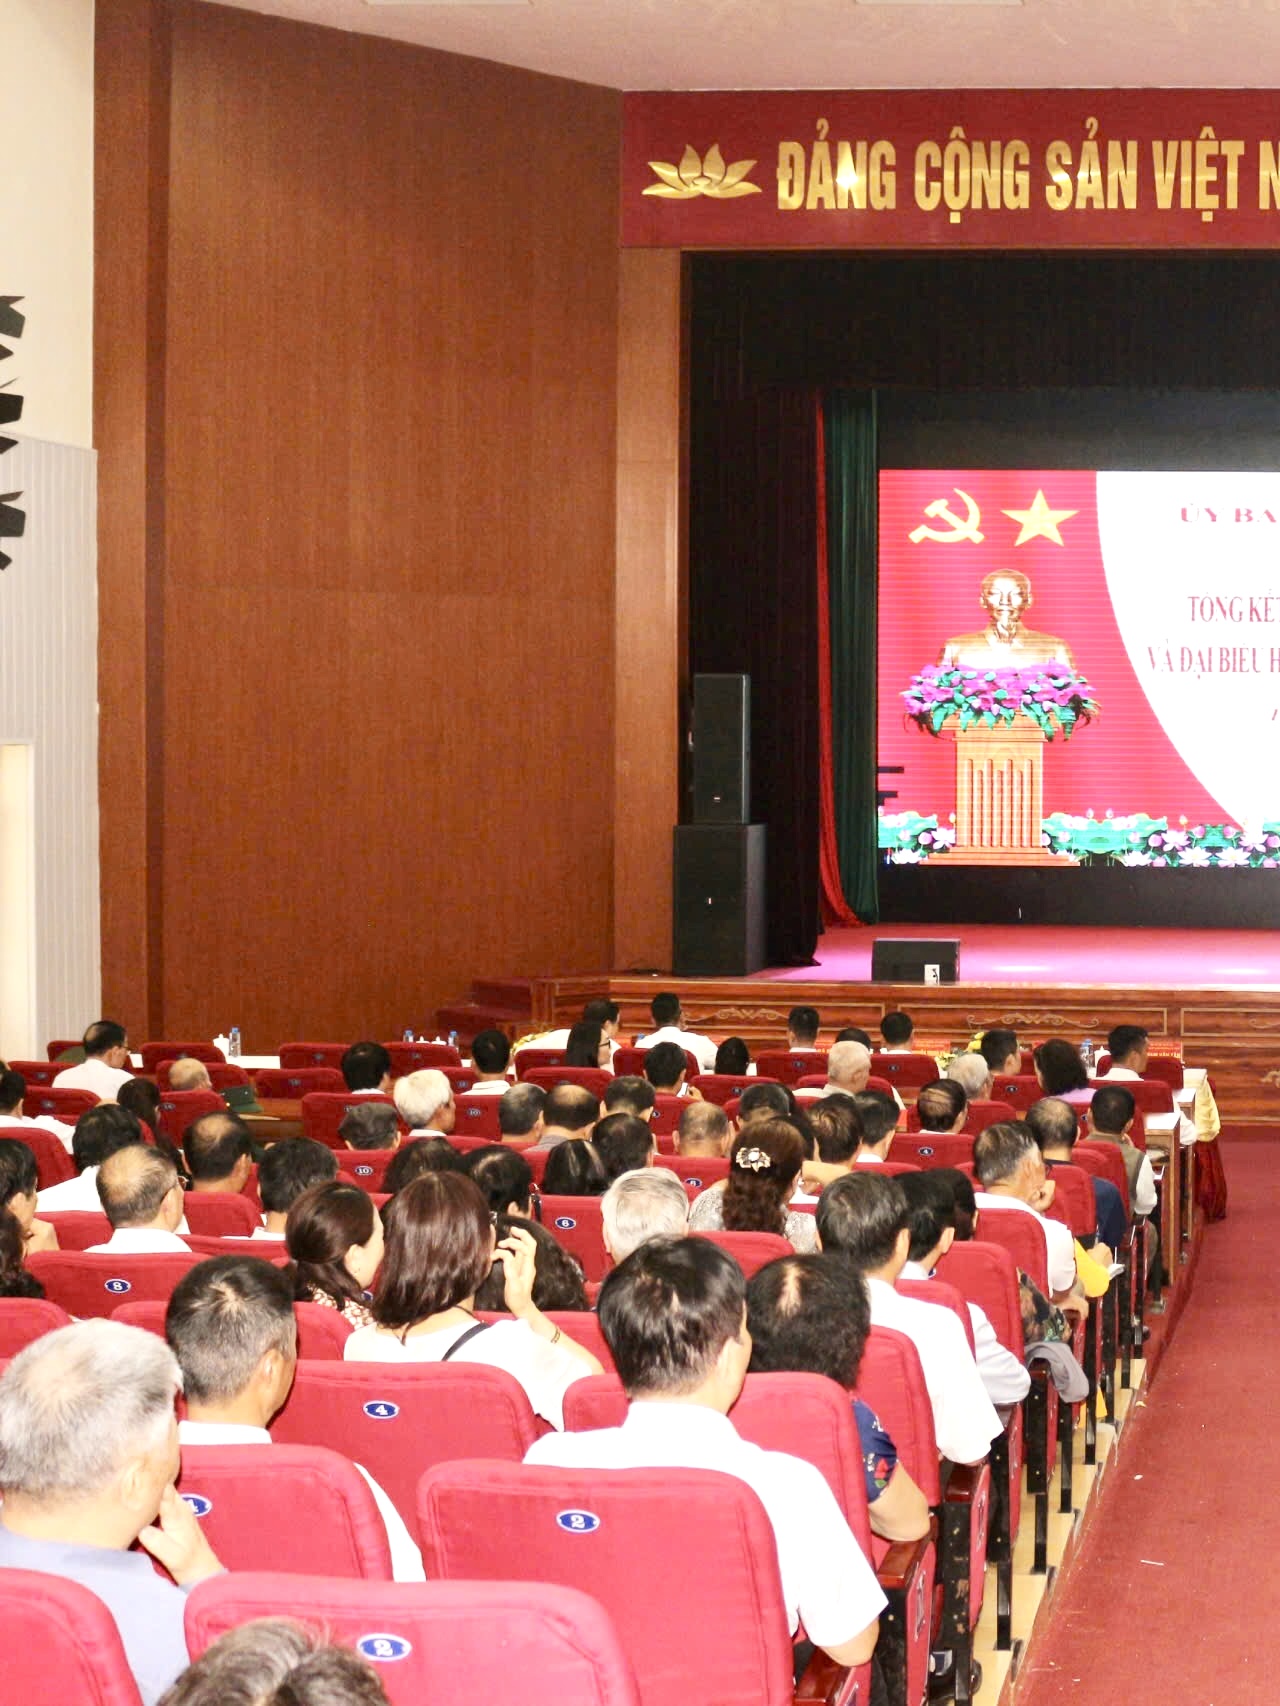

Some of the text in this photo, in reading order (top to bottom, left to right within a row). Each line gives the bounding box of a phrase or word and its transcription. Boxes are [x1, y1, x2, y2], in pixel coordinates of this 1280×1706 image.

[776, 117, 897, 210] ĐẢNG
[914, 126, 1030, 223] CỘNG
[1045, 116, 1138, 210] SẢN
[1151, 126, 1246, 221] VIỆT
